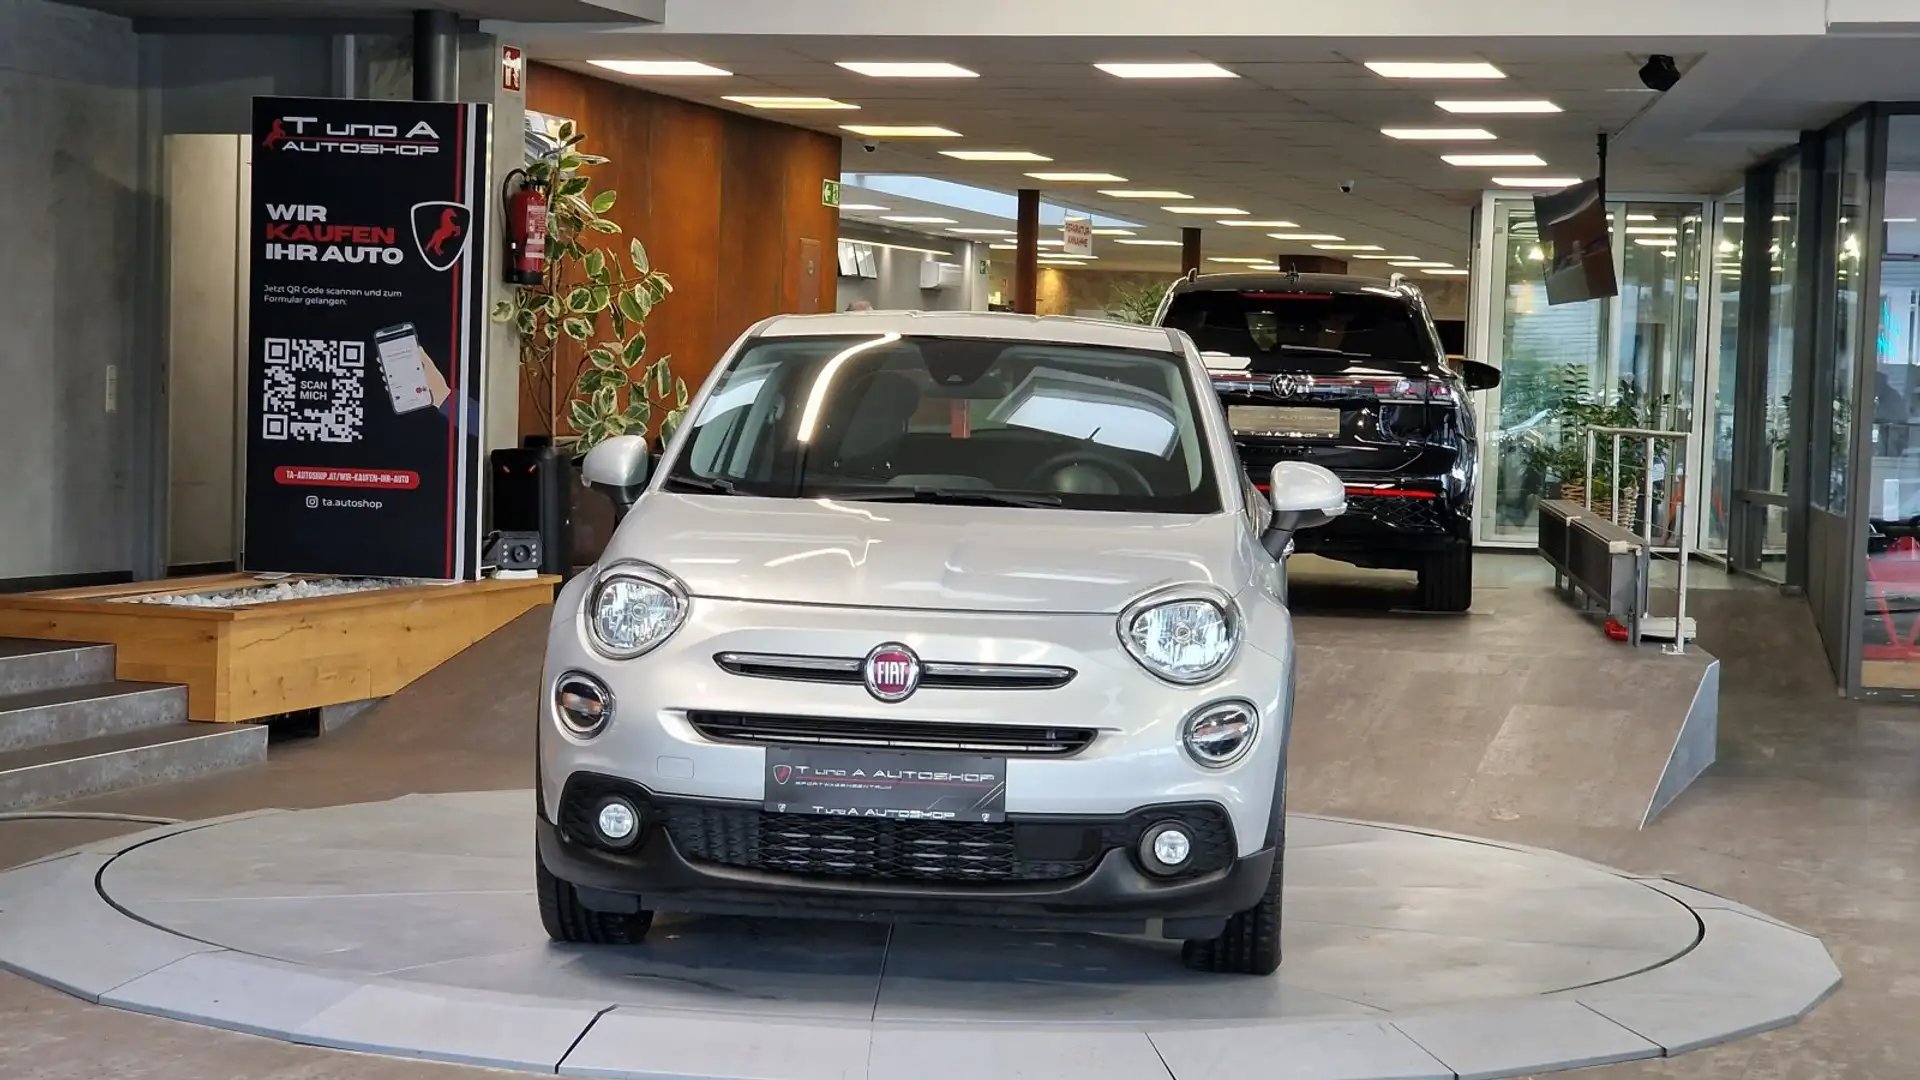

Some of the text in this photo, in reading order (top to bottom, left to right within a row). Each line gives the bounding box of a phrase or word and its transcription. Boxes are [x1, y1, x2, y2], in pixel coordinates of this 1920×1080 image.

[282, 116, 318, 134] T
[405, 120, 440, 139] A
[282, 140, 440, 156] AUTOSHOP
[266, 203, 327, 222] WIR
[266, 223, 395, 244] KAUFEN
[266, 243, 404, 264] IHR AUTO
[264, 284, 402, 298] Jetzt QR Code scannen und zum
[264, 294, 303, 304] Formular
[300, 380, 328, 390] SCAN
[300, 390, 328, 400] MICH
[322, 498, 383, 510] ta.autoshop
[877, 661, 908, 685] FIAT
[795, 765, 809, 775] T
[852, 769, 866, 778] A
[873, 770, 995, 783] AUTOSHOP
[864, 808, 956, 820] AUTOSHOP
